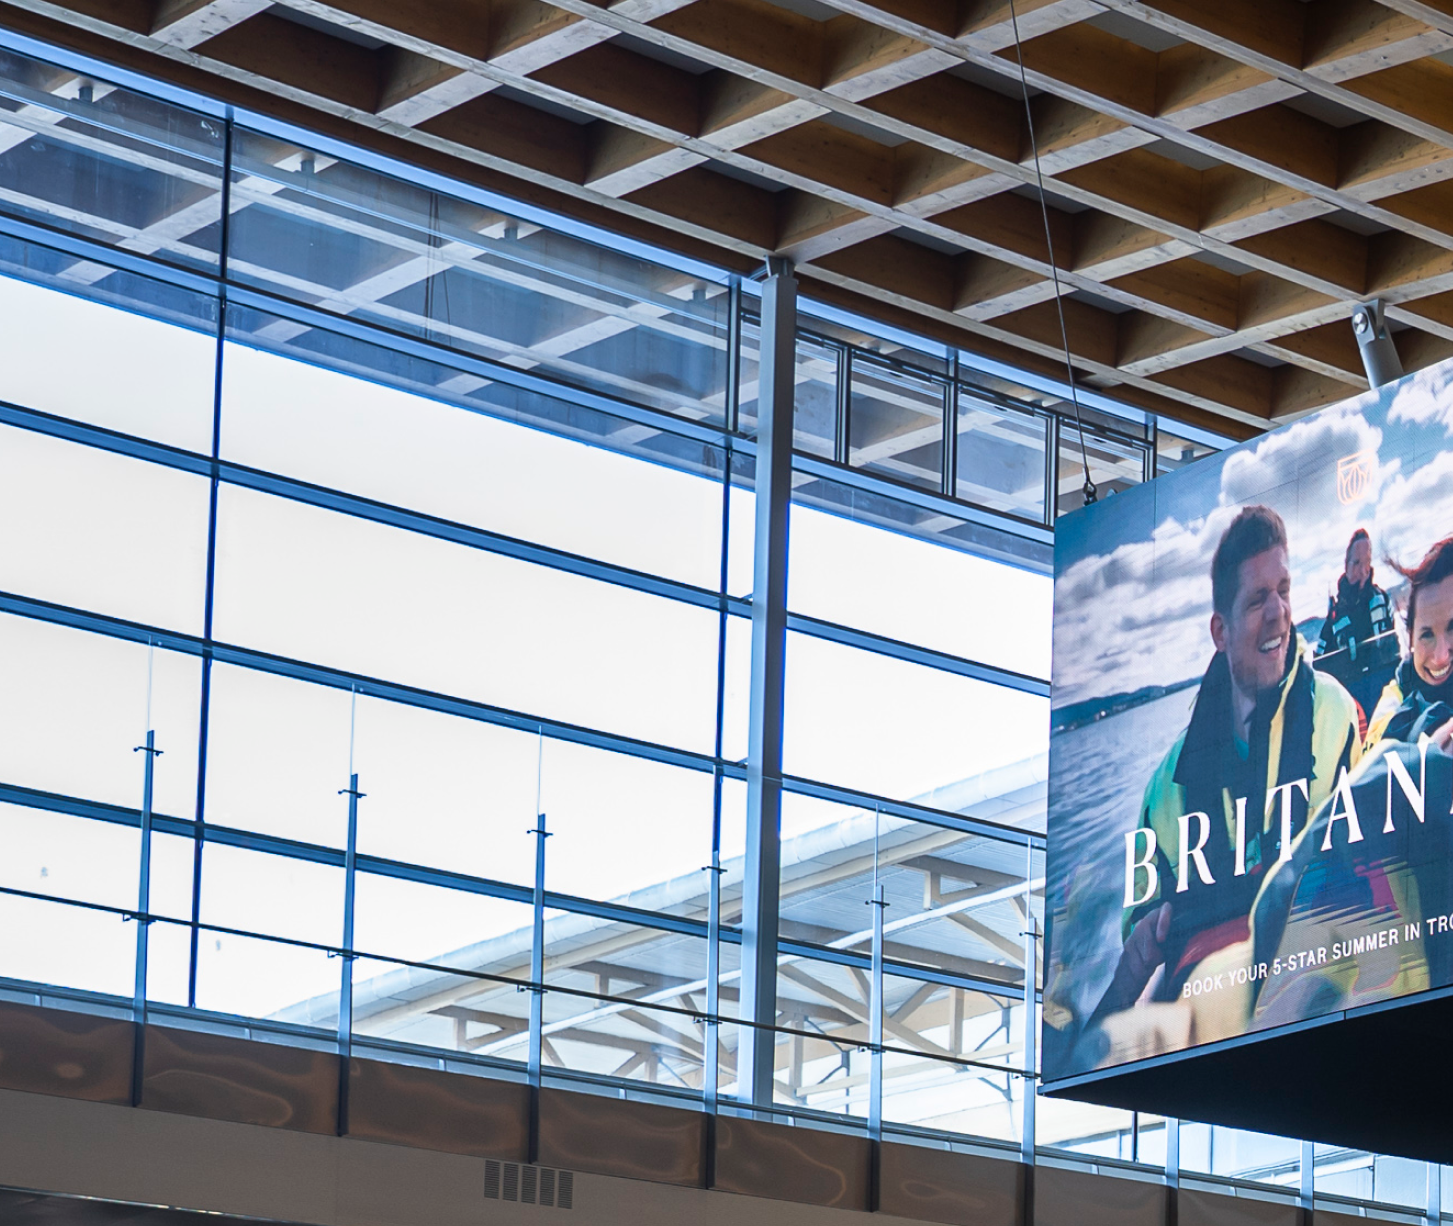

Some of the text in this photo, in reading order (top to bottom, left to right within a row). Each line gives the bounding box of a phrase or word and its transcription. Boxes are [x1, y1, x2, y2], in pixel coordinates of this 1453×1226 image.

[1182, 979, 1223, 999] BOOK
[1228, 964, 1268, 988] YOUR
[1273, 947, 1327, 977] 5-STAR
[1331, 928, 1400, 960] SUMMER
[1404, 922, 1421, 942] IN
